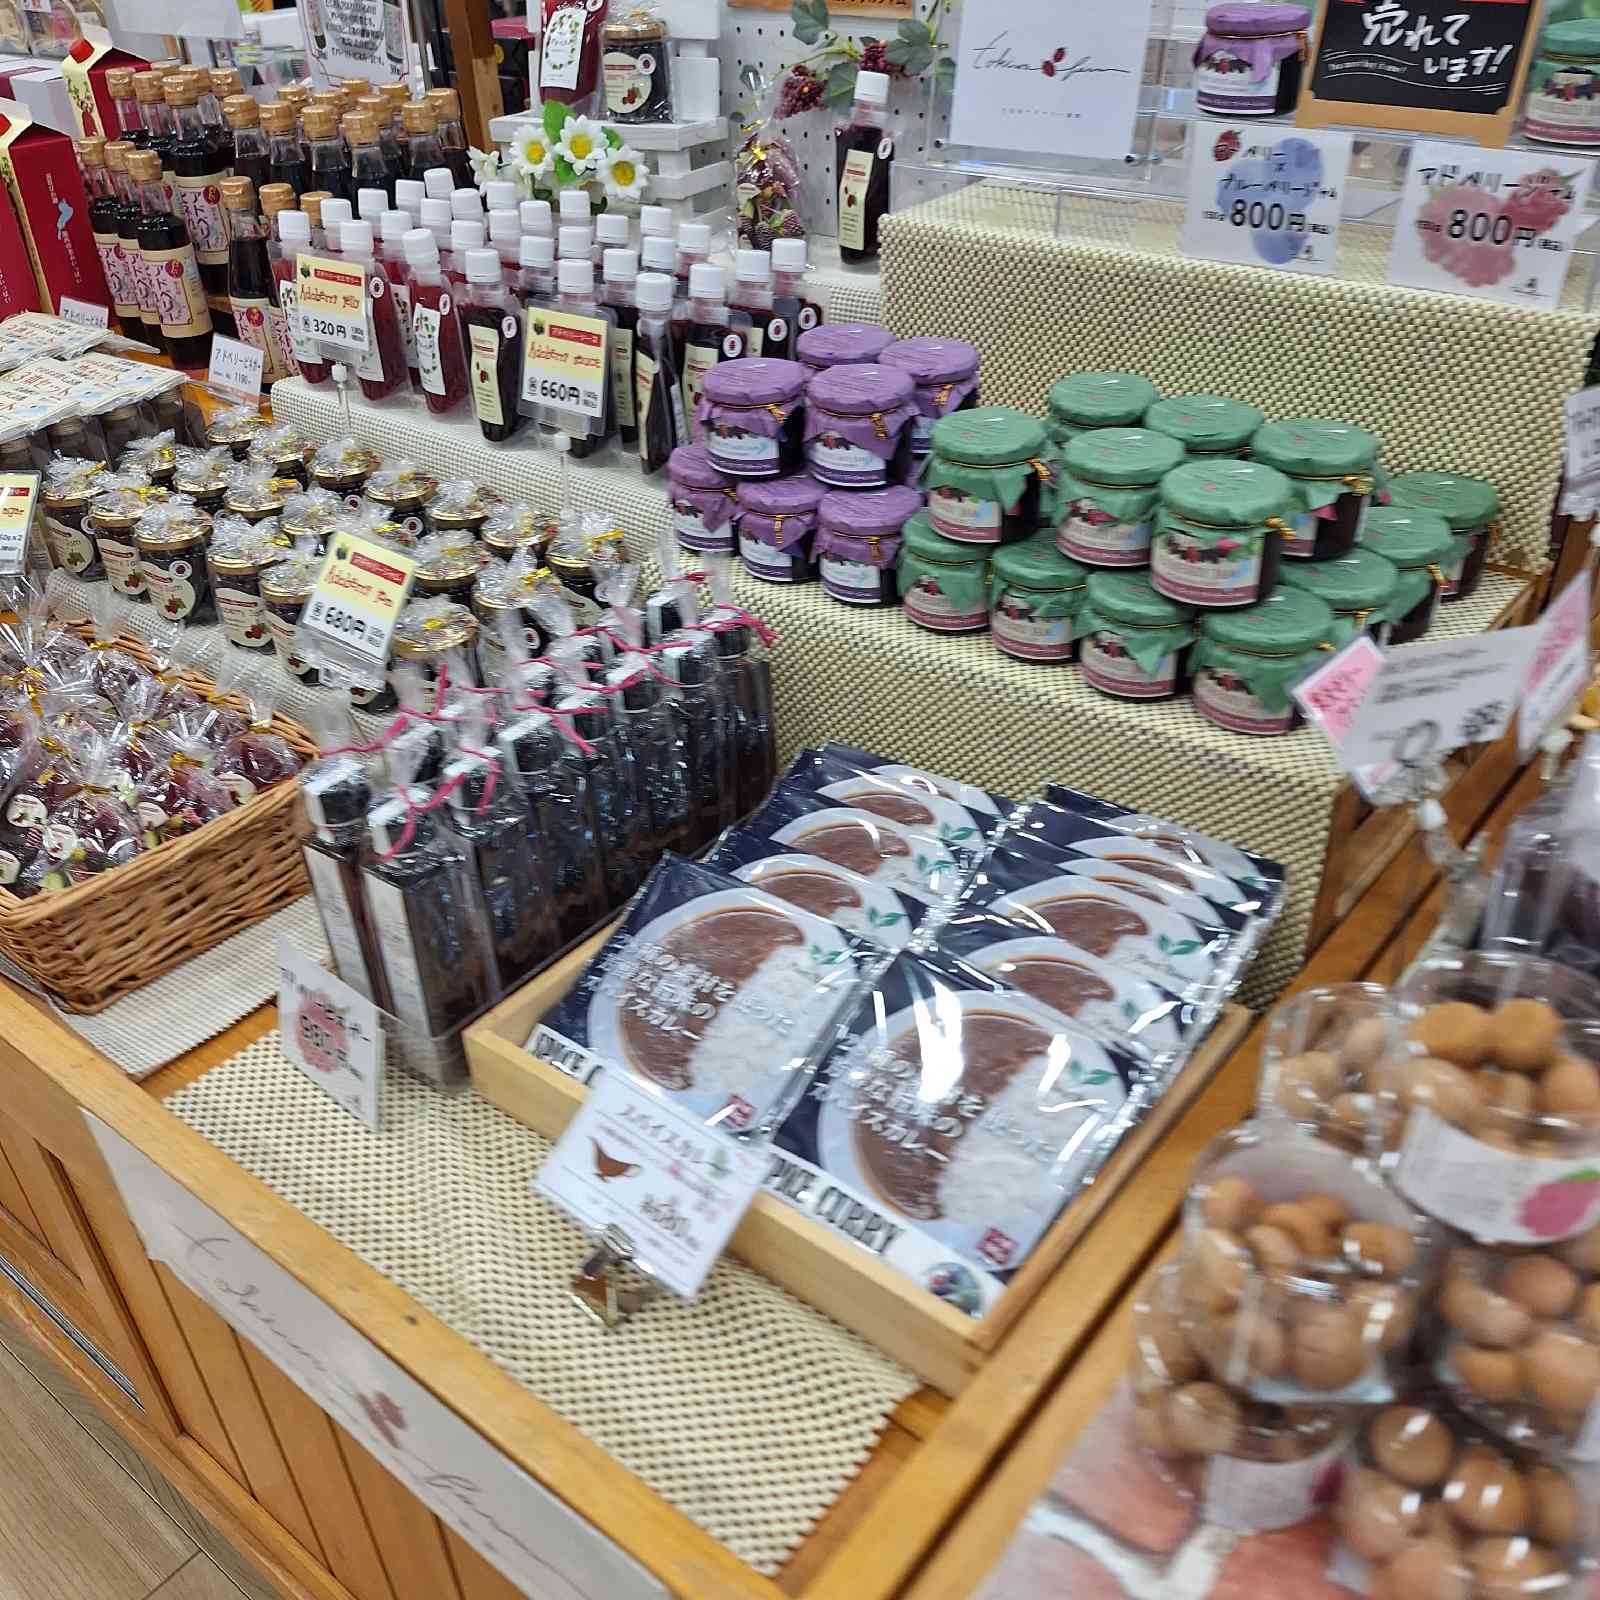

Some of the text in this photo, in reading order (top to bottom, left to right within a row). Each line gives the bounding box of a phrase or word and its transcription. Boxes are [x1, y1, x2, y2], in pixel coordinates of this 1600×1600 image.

[1362, 0, 1471, 52] 売れて
[1230, 198, 1307, 232] 800円
[1448, 208, 1537, 248] 800円
[312, 318, 347, 339] 320円
[541, 380, 580, 405] 660円
[325, 606, 367, 640] 680円
